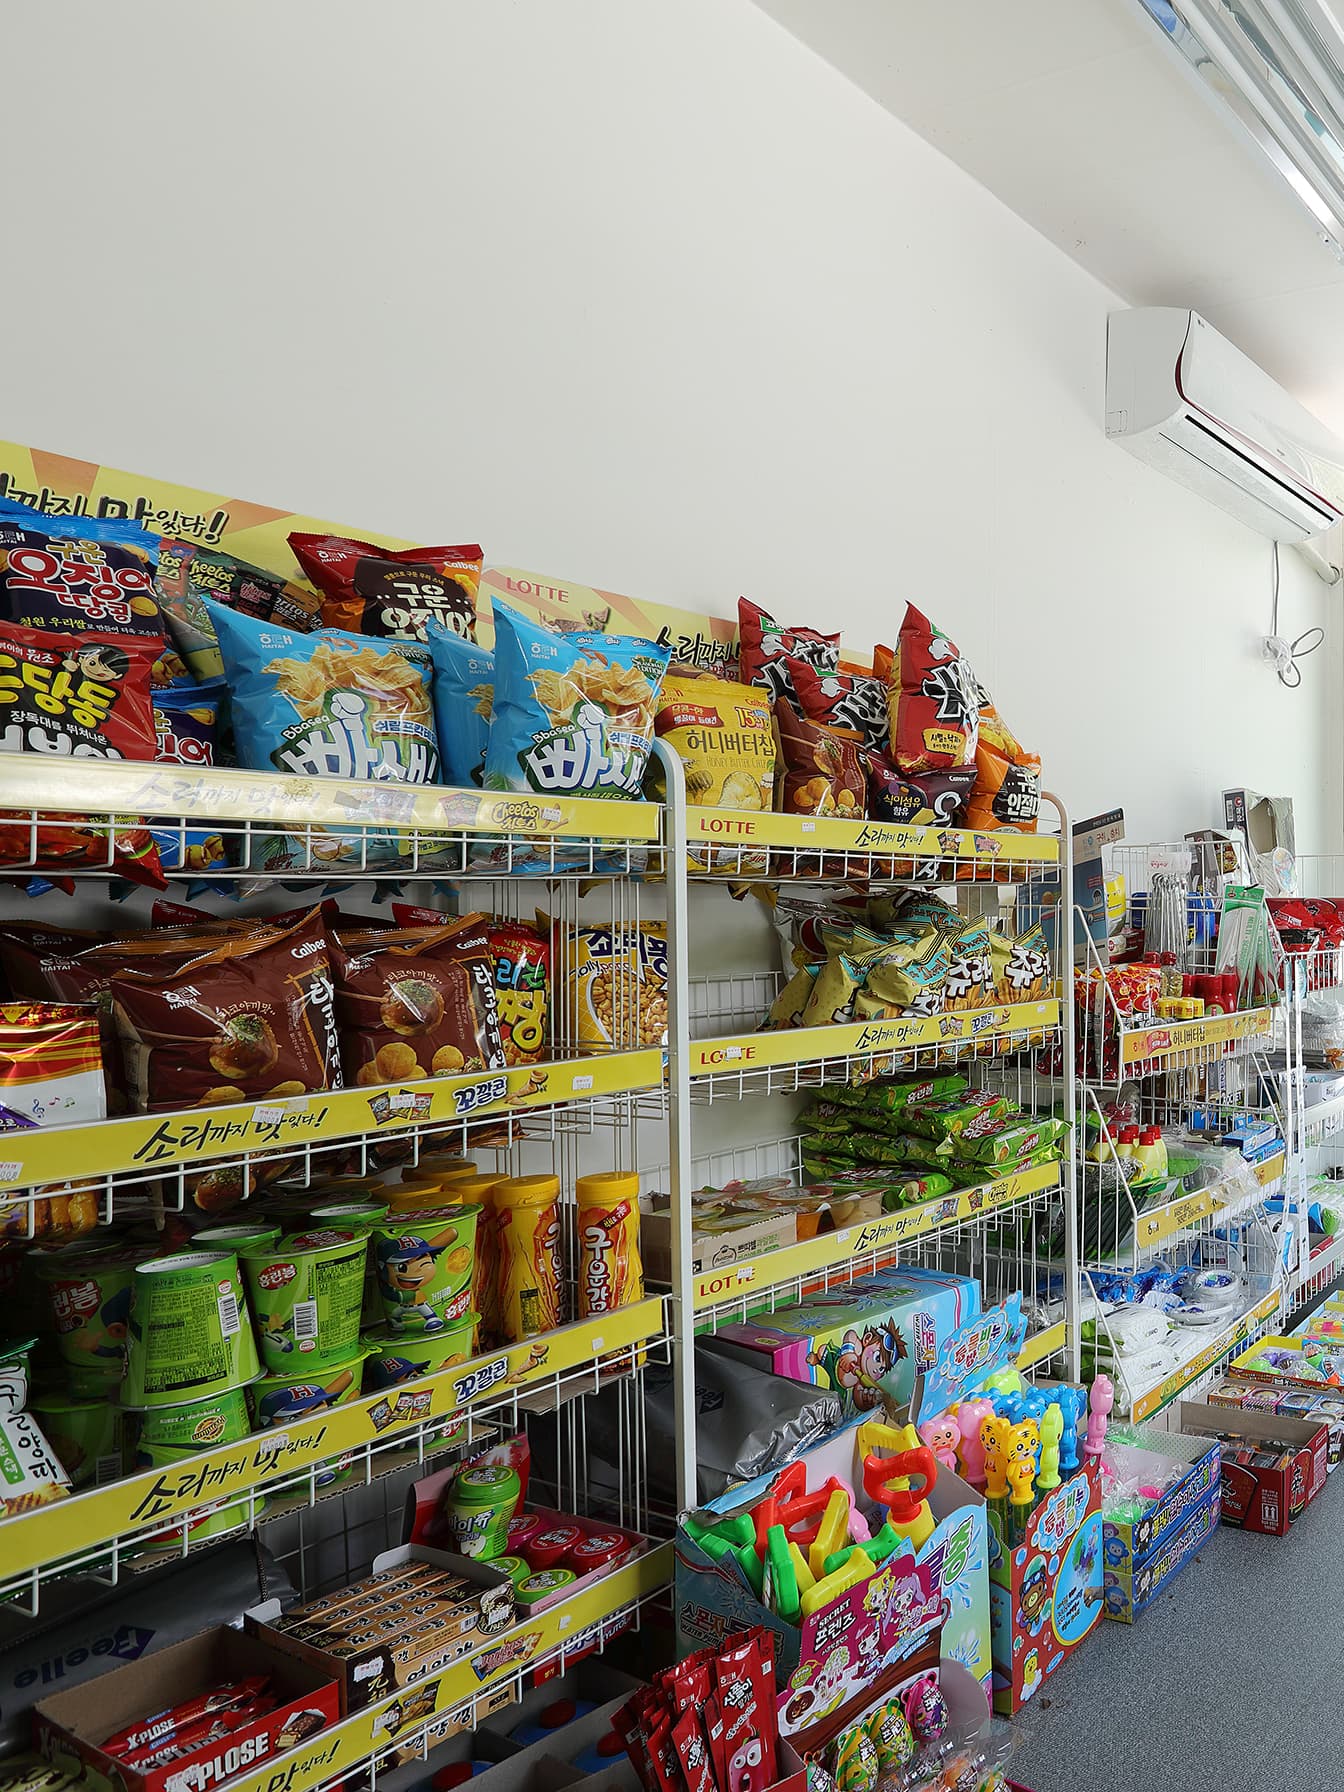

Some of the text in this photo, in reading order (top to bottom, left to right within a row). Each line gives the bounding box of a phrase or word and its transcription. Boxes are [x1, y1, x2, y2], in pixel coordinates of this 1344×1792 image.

[7, 547, 157, 602] 오징어
[191, 559, 236, 582] heetos
[443, 560, 480, 572] Calbee
[392, 582, 451, 609] 구운
[506, 577, 569, 603] LOTTE
[56, 593, 132, 623] 땅콩
[26, 650, 55, 664] 원조
[10, 709, 62, 731] 장독대를
[686, 730, 774, 756] 허니버터칩
[884, 794, 921, 807] 식이섬유
[893, 806, 909, 816] 함유
[700, 818, 756, 835] LOTTE
[855, 825, 895, 849] 소리까지
[290, 938, 327, 960] Calbee
[387, 969, 438, 984] 타코야끼맛
[855, 1027, 895, 1050] 소리까지
[1172, 1025, 1206, 1046] 허니버터칩
[701, 1047, 755, 1066] LOTE
[452, 1076, 508, 1115] 꼬깔콘
[133, 1119, 249, 1161] 소리까지
[400, 1237, 419, 1250] H
[853, 1224, 894, 1251] 소리까지
[453, 1356, 509, 1401] 꼬깔콘
[290, 1385, 312, 1400] H
[131, 1457, 248, 1520] 소리까지
[818, 1598, 851, 1630] SECRET
[814, 1612, 857, 1653] 프렌즈
[126, 1718, 176, 1751] X-PLOSE
